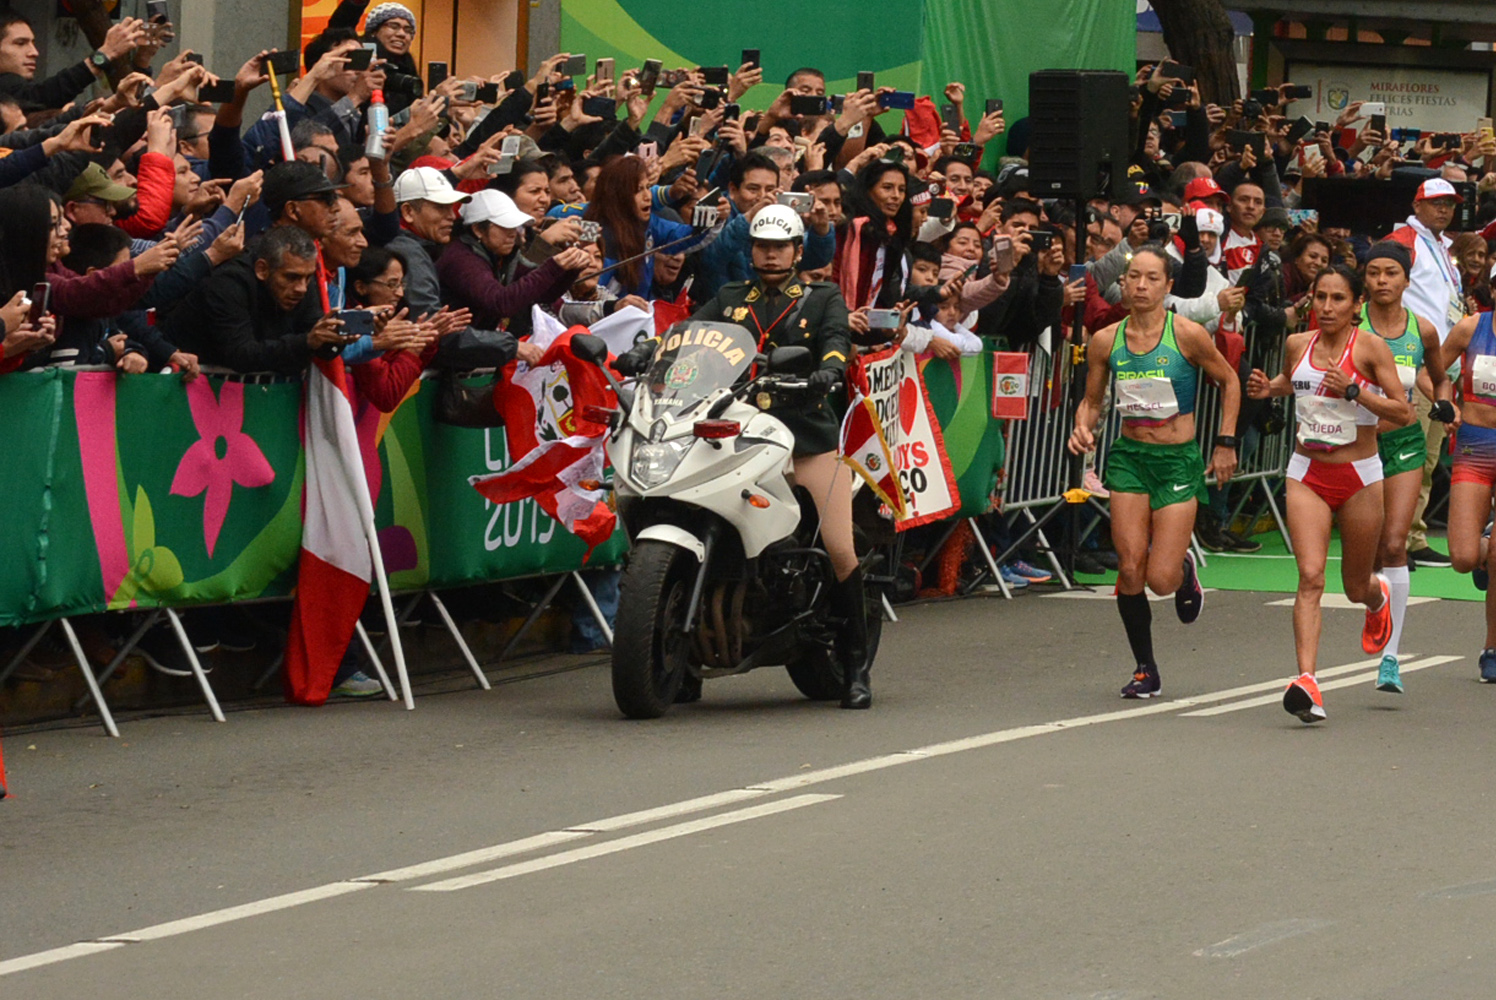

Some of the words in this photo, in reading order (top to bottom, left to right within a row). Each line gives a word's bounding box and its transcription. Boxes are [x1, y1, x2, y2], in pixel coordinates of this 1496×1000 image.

[1369, 81, 1440, 94] MIRAFLORES
[1369, 93, 1414, 106] FELICES
[1414, 95, 1457, 107] FIESTAS
[753, 216, 793, 236] POLICIA
[654, 328, 746, 367] POLICIA
[653, 398, 684, 407] YAMAHA
